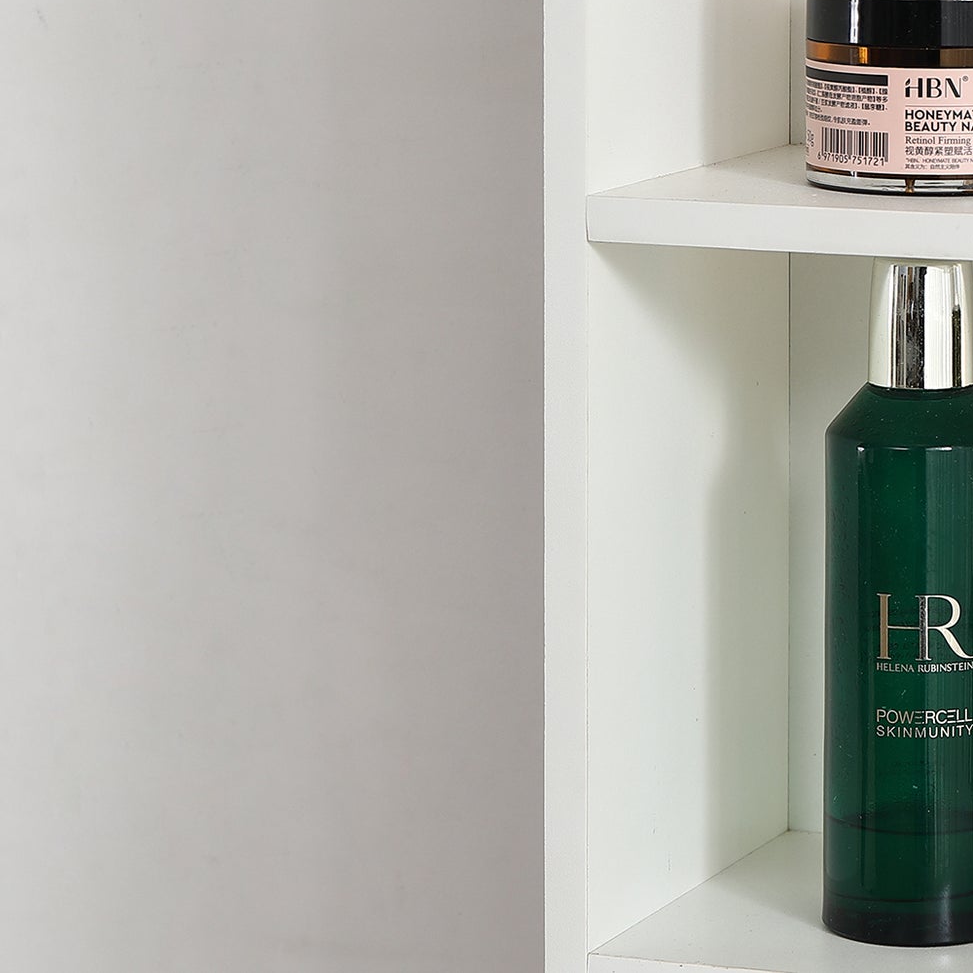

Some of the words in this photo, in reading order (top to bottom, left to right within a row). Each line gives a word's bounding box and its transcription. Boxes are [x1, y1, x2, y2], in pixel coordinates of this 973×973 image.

[905, 121, 957, 132] BEAUTY
[905, 136, 936, 144] Retinol
[938, 136, 972, 146] Firming
[876, 592, 973, 661] HR
[876, 662, 915, 673] HELENA
[917, 661, 973, 673] RUBINSTEIN
[876, 708, 973, 725] POWERCELL
[876, 724, 973, 739] SKINMUNITY
